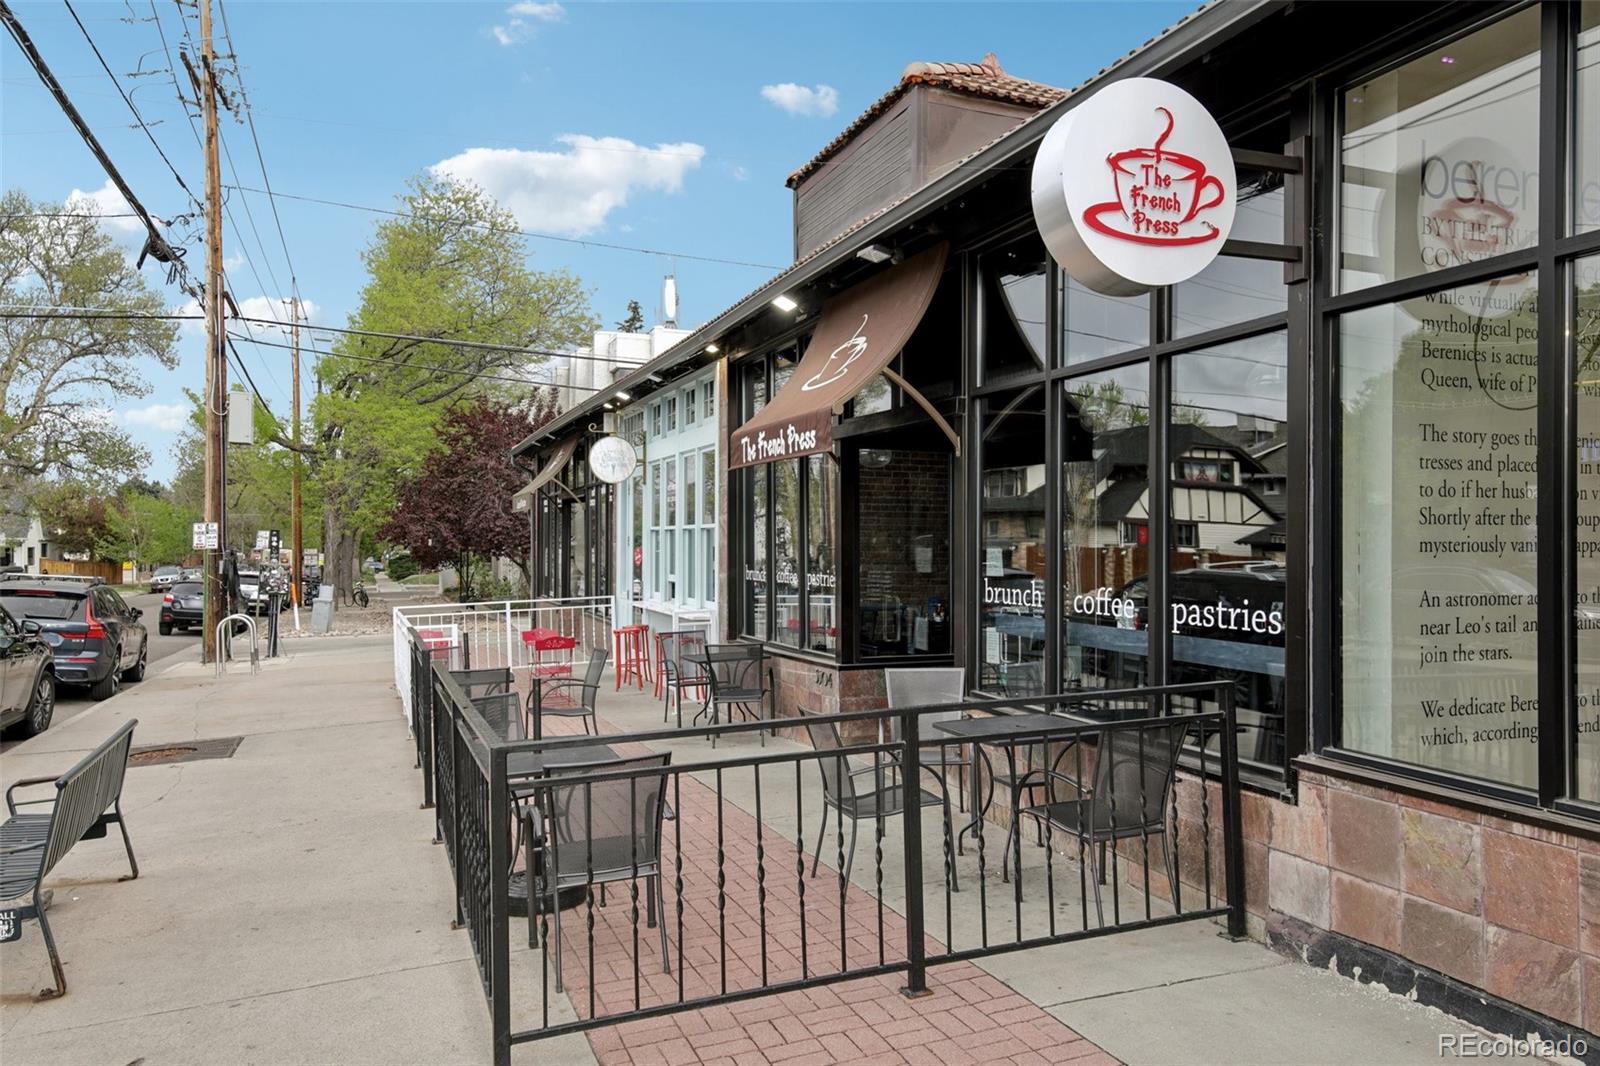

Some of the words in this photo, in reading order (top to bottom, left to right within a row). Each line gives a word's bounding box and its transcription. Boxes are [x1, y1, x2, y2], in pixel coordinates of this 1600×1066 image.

[1141, 164, 1172, 188] The
[1130, 185, 1181, 213] French
[1133, 209, 1179, 235] Press
[1421, 216, 1444, 237] BY
[1448, 219, 1488, 242] THE
[1421, 314, 1511, 341] mythological
[1421, 340, 1487, 362] Berenices
[1491, 346, 1502, 363] is
[1421, 368, 1472, 392] Queen,
[1478, 373, 1506, 391] wife
[1510, 374, 1526, 391] of
[741, 436, 757, 463] The
[758, 431, 785, 459] French
[787, 424, 816, 454] Press
[1419, 423, 1448, 442] The
[1452, 431, 1487, 449] story
[1491, 432, 1520, 450] goes
[1419, 457, 1463, 470] tresses
[1467, 453, 1492, 471] and
[1498, 454, 1538, 477] placed
[1420, 485, 1434, 498] to
[1438, 480, 1456, 498] do
[1461, 480, 1473, 498] if
[1475, 480, 1498, 498] her
[1419, 506, 1471, 531] Shortly
[1475, 507, 1506, 525] after
[1511, 508, 1531, 525] the
[1420, 534, 1507, 558] mysteriously
[807, 570, 836, 590] pastrie
[984, 578, 1043, 607] brunch
[1073, 587, 1135, 618] coffee
[1171, 599, 1283, 635] pastries
[1420, 590, 1441, 607] An
[1445, 594, 1523, 607] astronomer
[1420, 623, 1450, 635] near
[1456, 615, 1491, 634] Leo's
[1496, 614, 1516, 632] tail
[1420, 645, 1447, 669] join
[1453, 643, 1475, 661] the
[1479, 647, 1512, 660] stars.
[1421, 700, 1444, 718] We
[1449, 697, 1506, 716] dedicate
[1421, 725, 1468, 746] which,
[1473, 721, 1539, 743] according
